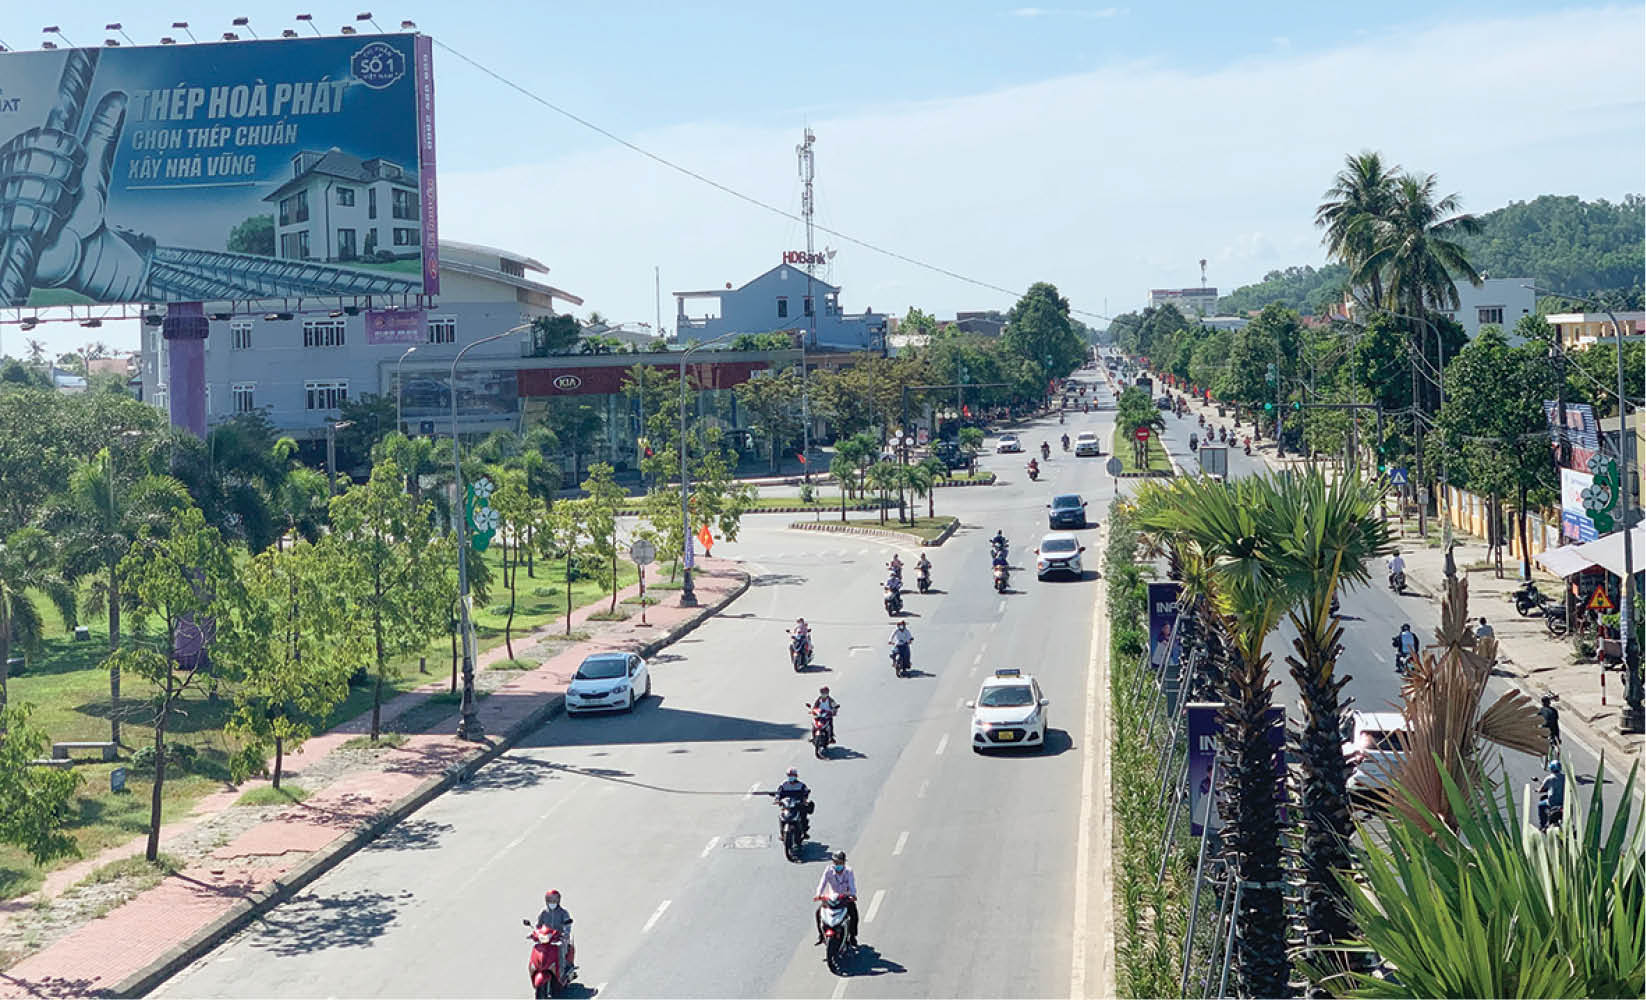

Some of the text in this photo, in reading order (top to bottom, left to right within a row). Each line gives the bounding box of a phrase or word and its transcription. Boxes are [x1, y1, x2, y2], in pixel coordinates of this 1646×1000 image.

[360, 55, 394, 73] SỐ 1
[135, 75, 346, 121] THÉP HOÀ PHÁT
[132, 128, 182, 155] CHỌN
[187, 123, 231, 149] THÉP
[128, 155, 162, 179] XÂY
[165, 153, 202, 178] NHÀ
[782, 250, 826, 265] HDBank
[559, 378, 577, 388] KIA
